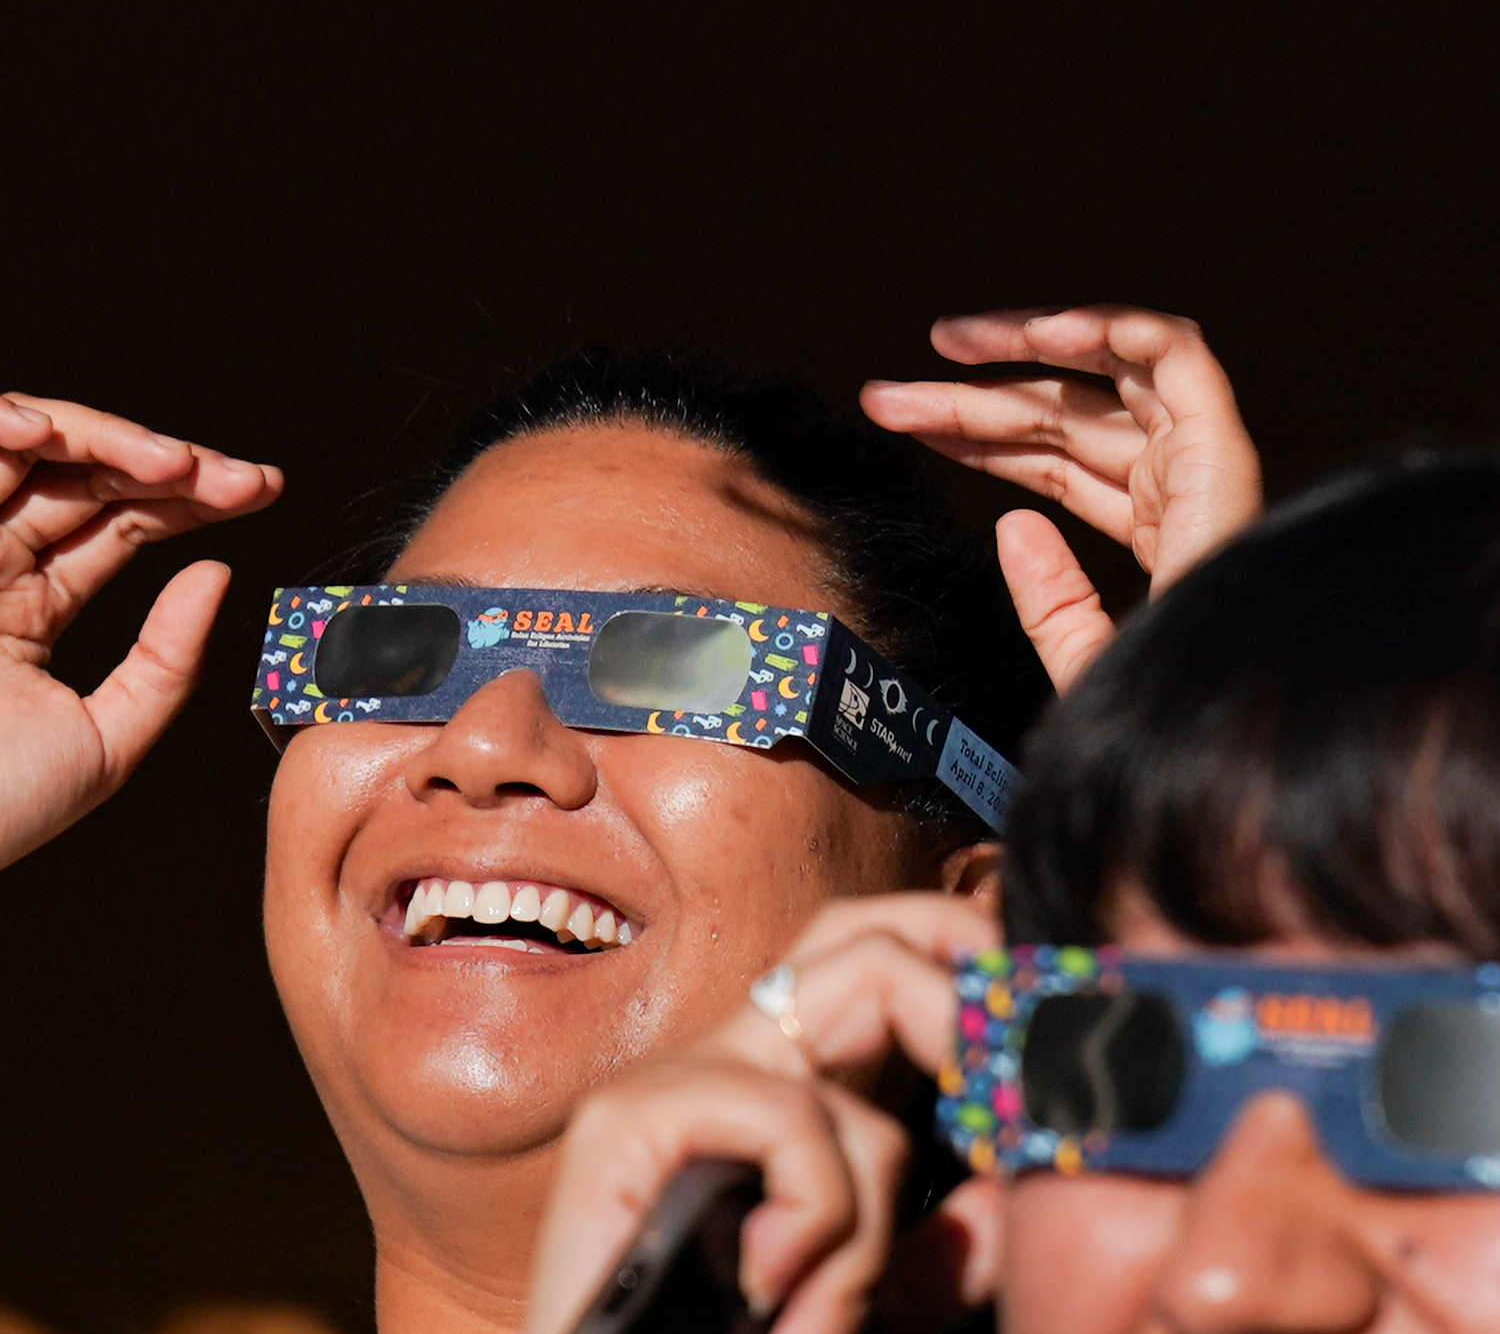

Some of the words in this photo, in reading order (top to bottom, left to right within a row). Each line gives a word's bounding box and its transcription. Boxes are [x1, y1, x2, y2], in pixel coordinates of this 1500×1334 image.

[513, 611, 594, 634] SEAL
[950, 759, 976, 789] April
[987, 791, 1006, 815] 202
[960, 738, 985, 769] Total
[985, 761, 1009, 794] Eclip
